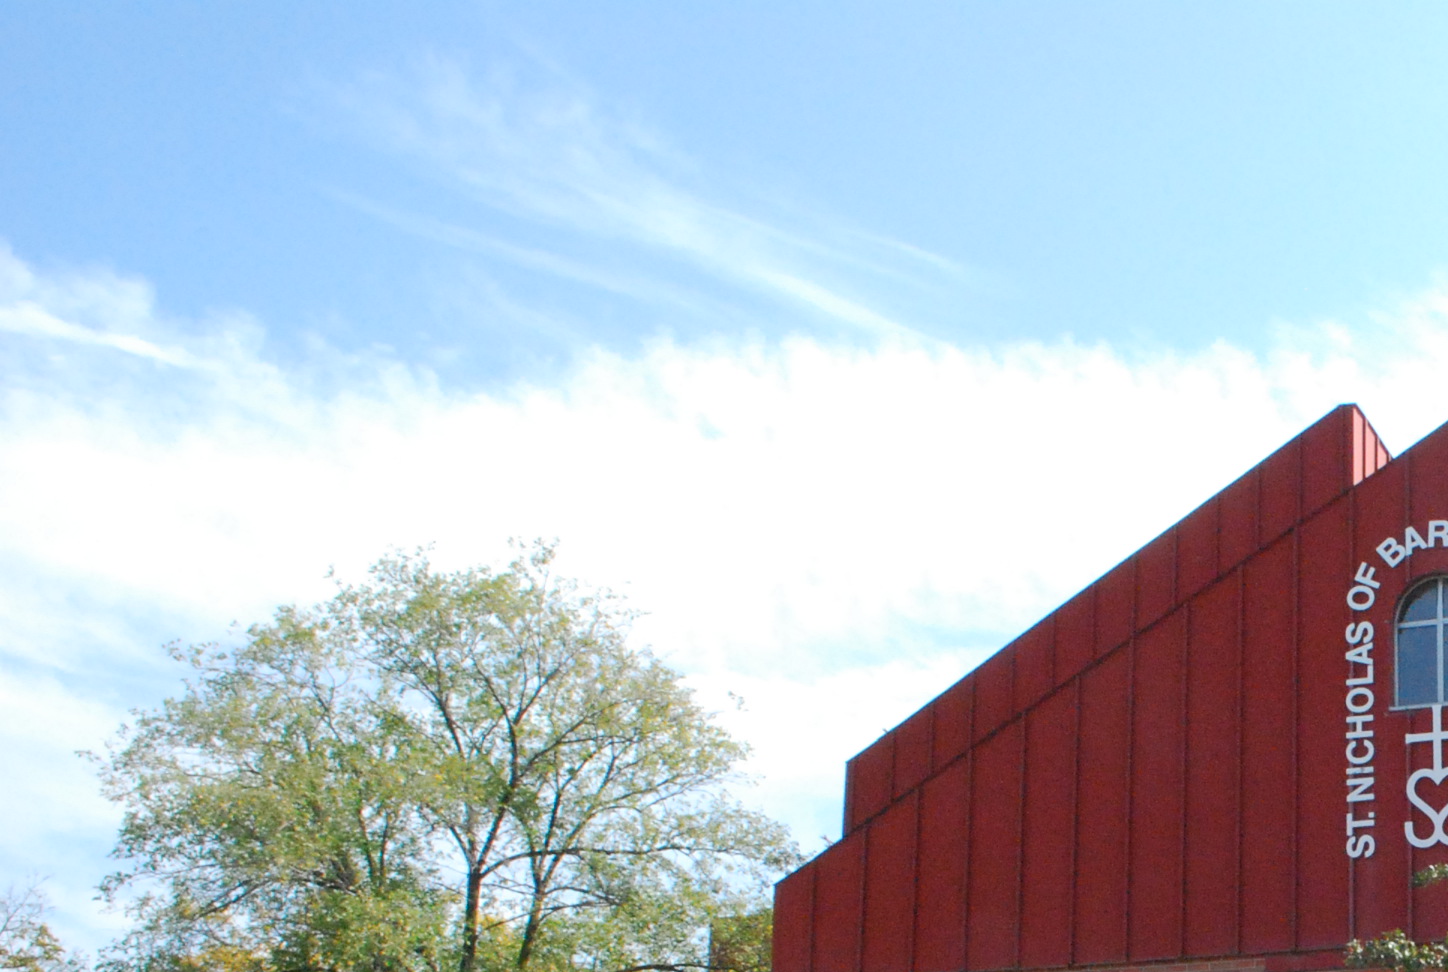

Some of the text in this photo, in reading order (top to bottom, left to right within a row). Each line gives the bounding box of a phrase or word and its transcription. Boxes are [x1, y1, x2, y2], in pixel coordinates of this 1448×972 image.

[1346, 562, 1381, 611] OF
[1345, 621, 1375, 801] NICHOLAS
[1346, 811, 1375, 858] ST.
